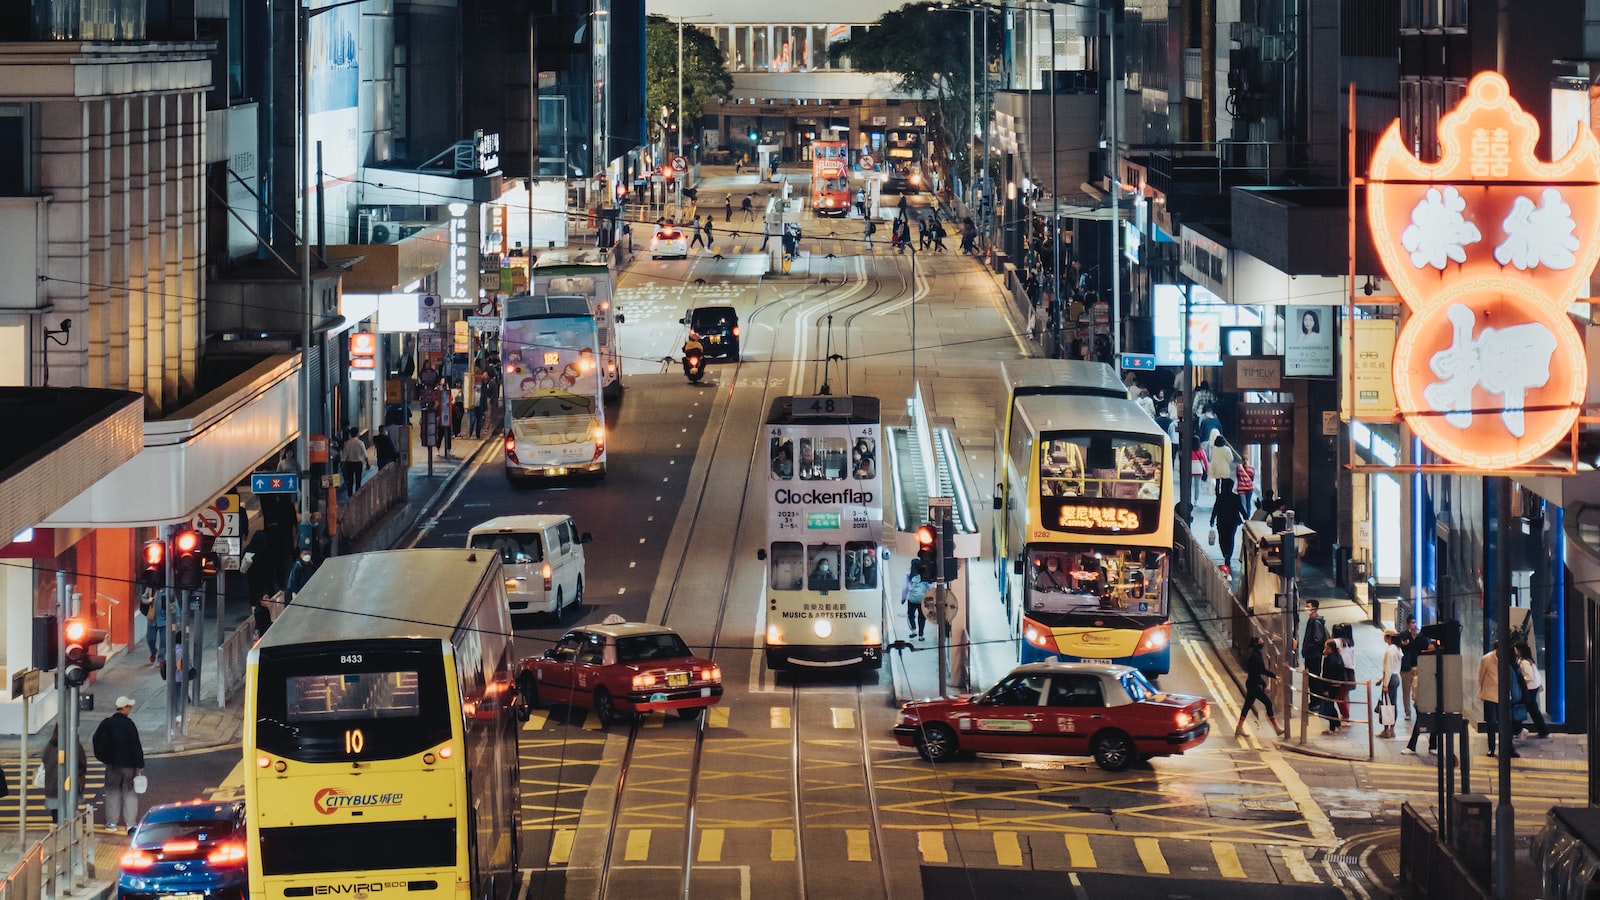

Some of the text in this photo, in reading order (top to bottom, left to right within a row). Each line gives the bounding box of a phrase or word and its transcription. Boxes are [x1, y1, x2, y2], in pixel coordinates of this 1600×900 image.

[543, 353, 559, 365] 182
[1243, 368, 1275, 378] TIMELY
[1423, 303, 1558, 439] 押
[810, 399, 835, 413] 48
[771, 428, 782, 436] 48
[862, 427, 873, 435] 48
[774, 488, 873, 507] Clockenflap
[227, 514, 233, 523] 7
[1116, 508, 1140, 529] 5B
[227, 527, 233, 535] 7
[803, 603, 847, 611] 音樂及藝術節
[782, 611, 807, 619] MUSIC
[835, 611, 867, 619] FESTIVAL
[863, 647, 875, 657] 48
[340, 654, 363, 664] 8433
[344, 729, 364, 754] 10
[326, 793, 403, 807] CITYBUS 城巴
[315, 883, 383, 895] ENVIRO
